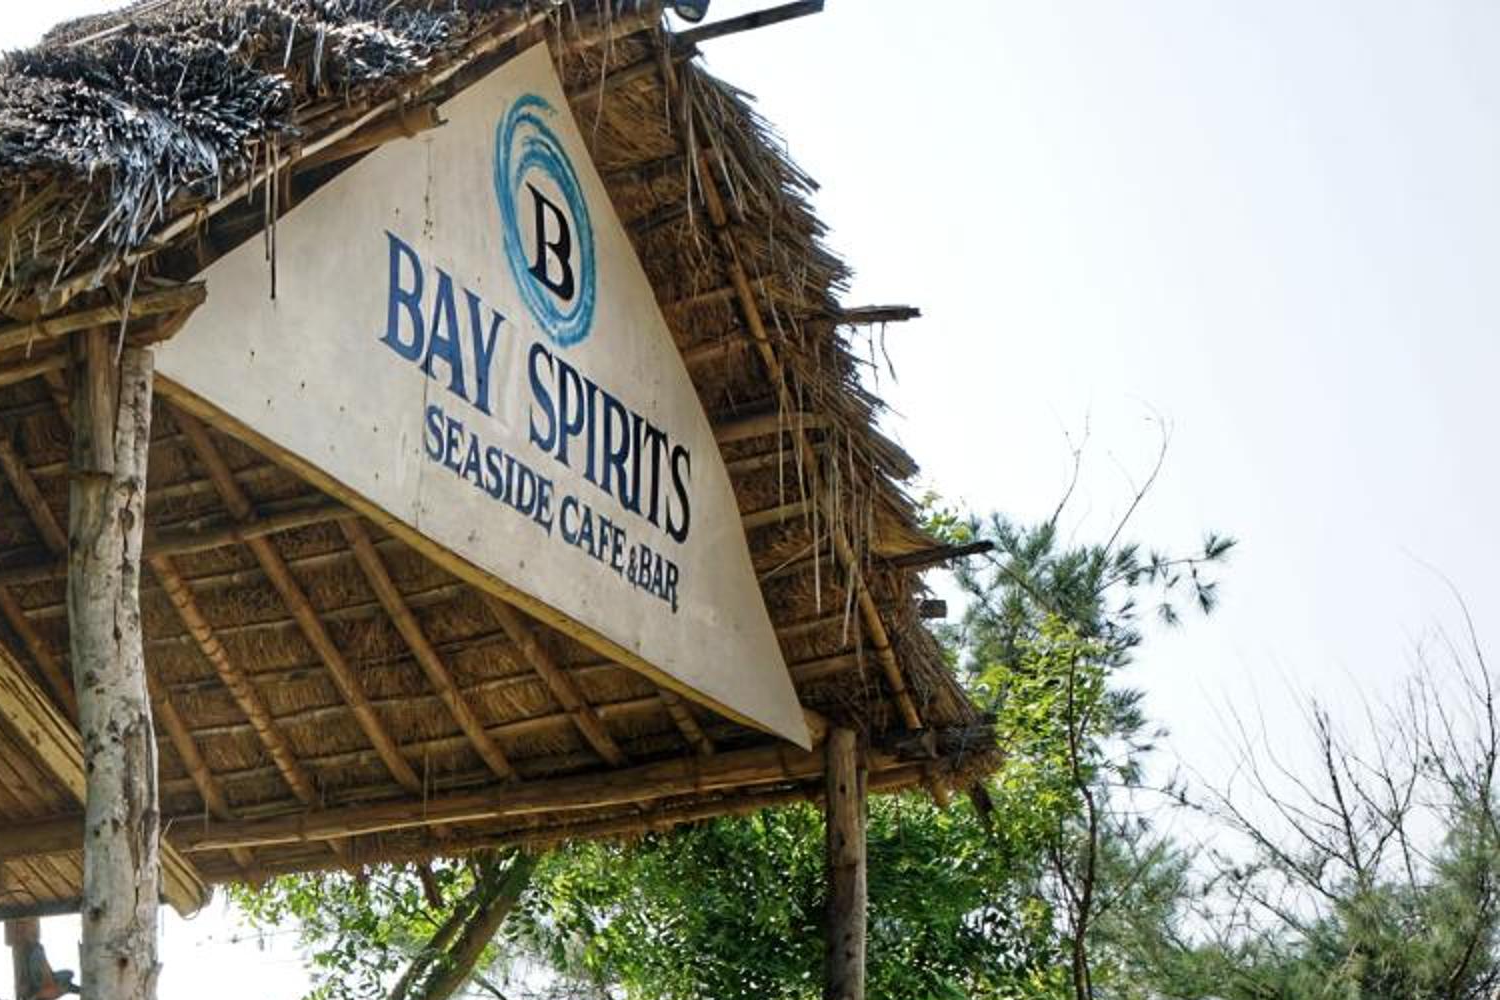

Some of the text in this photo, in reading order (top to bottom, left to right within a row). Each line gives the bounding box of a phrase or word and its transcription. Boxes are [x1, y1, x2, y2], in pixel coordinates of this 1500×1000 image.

[526, 182, 574, 301] B
[379, 229, 691, 544] BAY SPIRITS
[425, 405, 554, 537] SEASIDE
